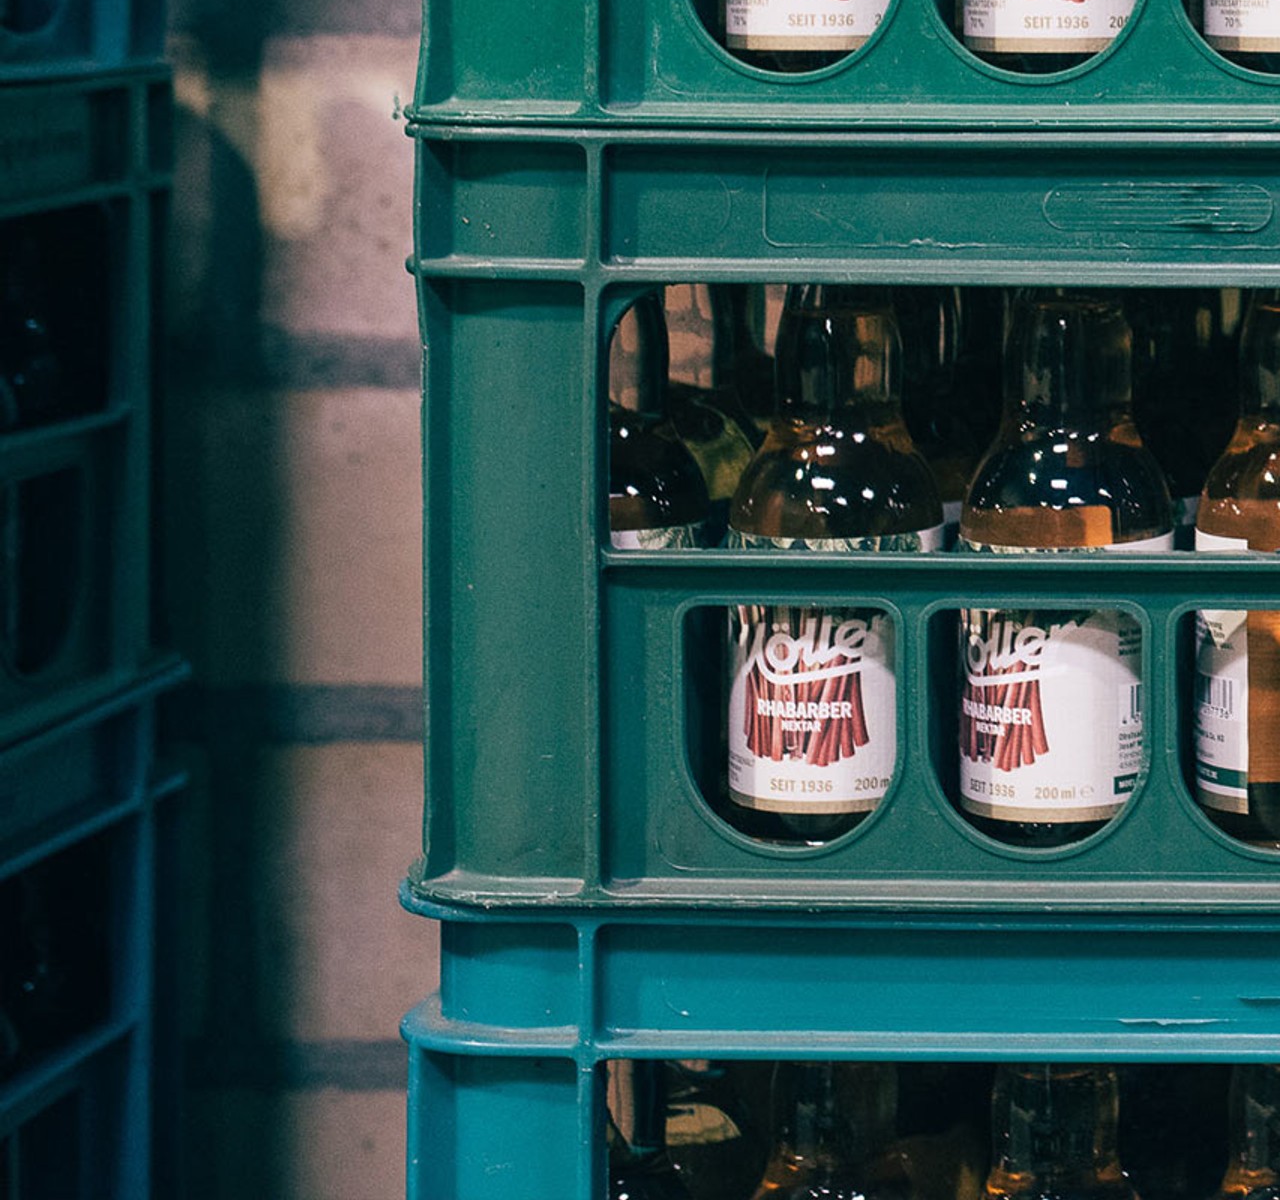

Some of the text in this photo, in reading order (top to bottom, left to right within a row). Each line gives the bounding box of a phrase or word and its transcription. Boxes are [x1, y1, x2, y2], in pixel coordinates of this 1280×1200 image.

[787, 13, 855, 26] SEIT 1936
[1024, 16, 1051, 29] SEIT
[1056, 16, 1089, 29] 1936
[757, 698, 852, 718] RHABARBER
[781, 720, 821, 732] NEKTAR
[769, 778, 796, 792] SEIT
[801, 780, 833, 792] 1936
[854, 777, 878, 790] 200
[970, 778, 985, 793] SEIT
[989, 782, 1015, 798] 1936
[1035, 786, 1058, 800] 200
